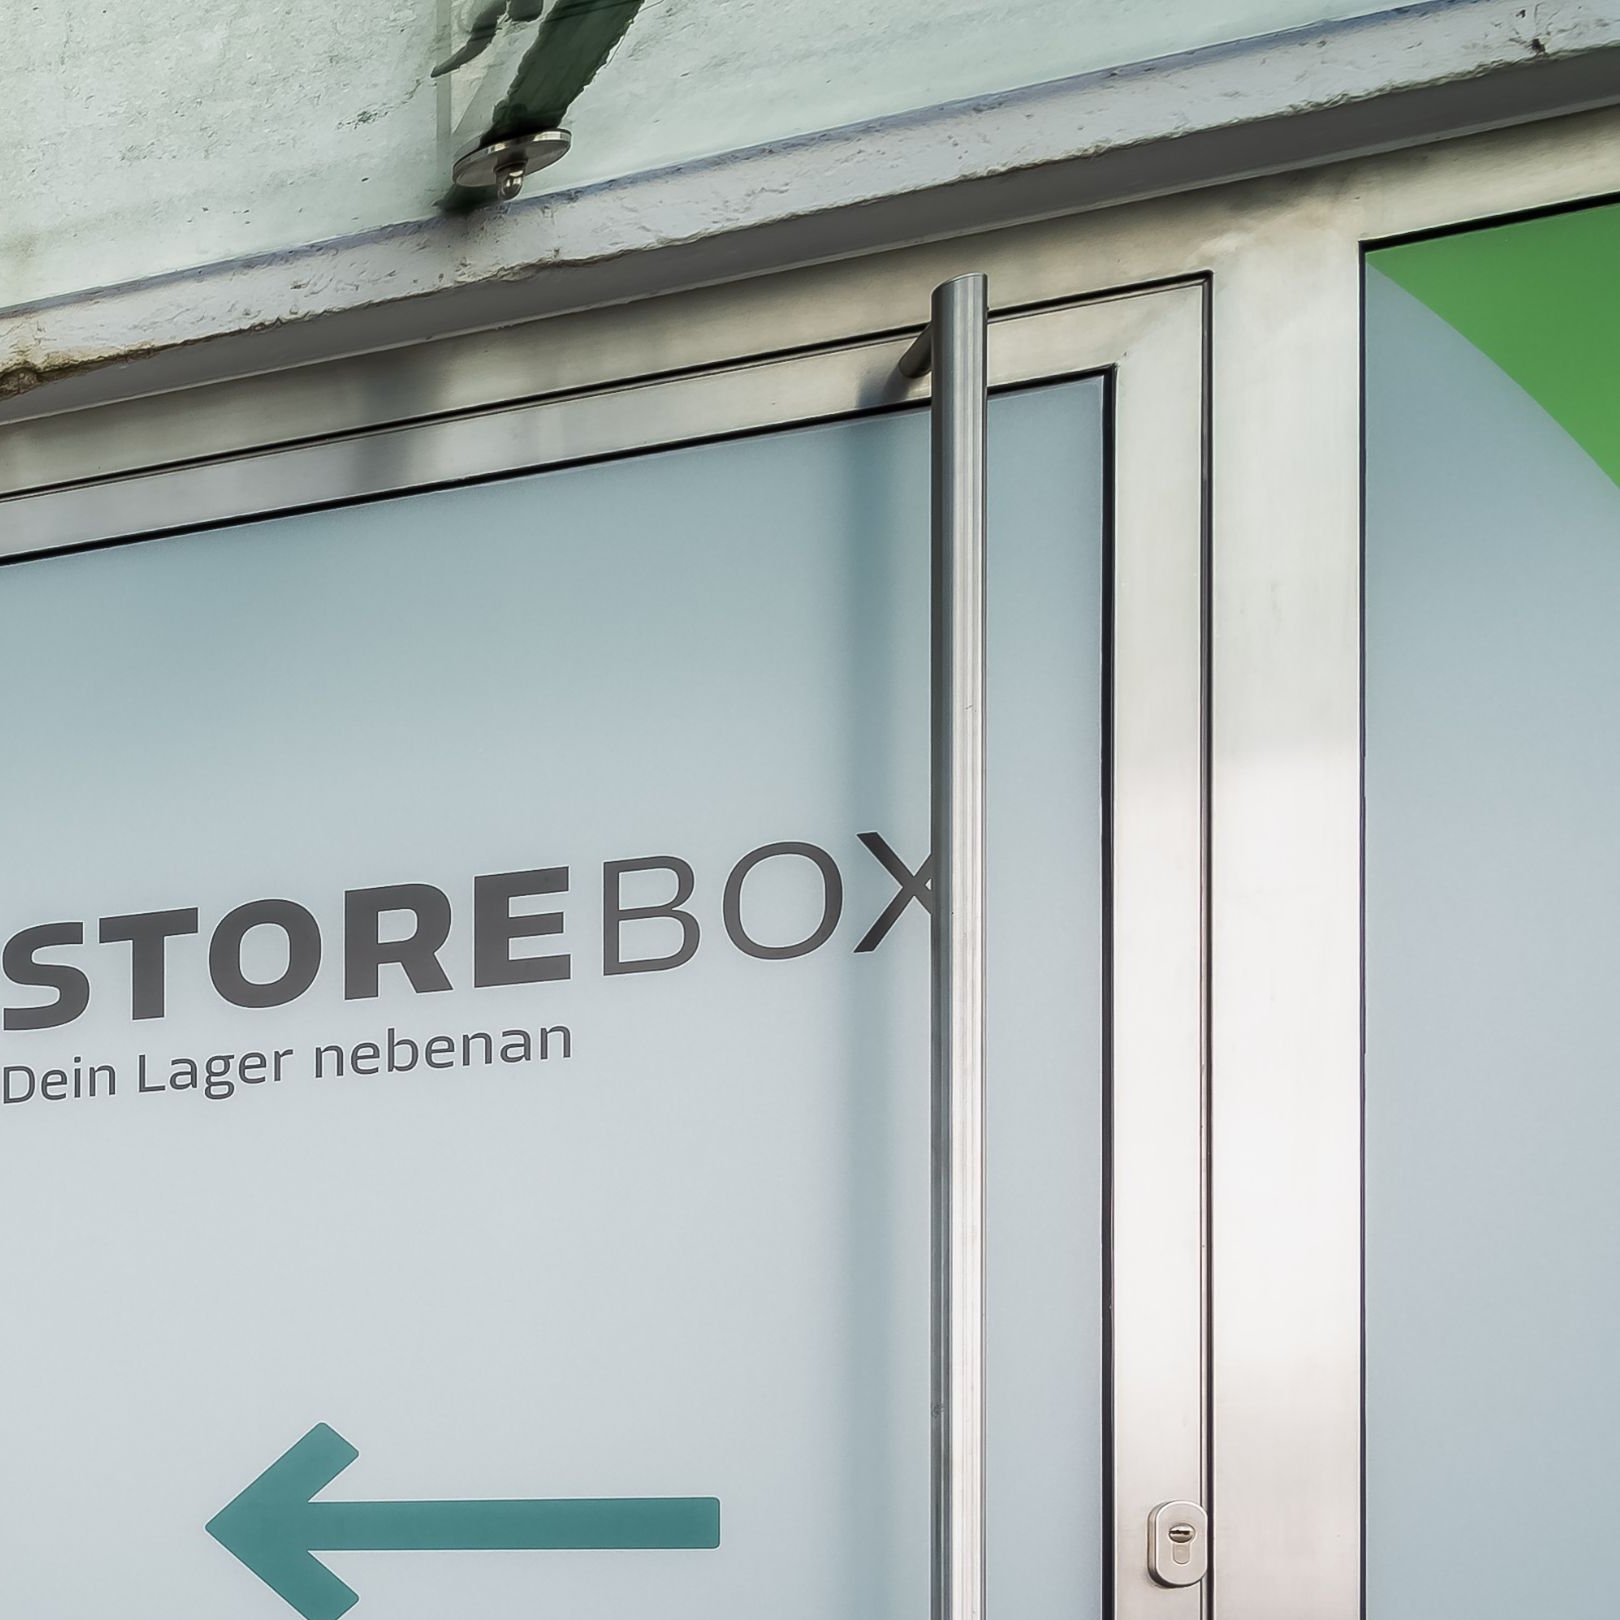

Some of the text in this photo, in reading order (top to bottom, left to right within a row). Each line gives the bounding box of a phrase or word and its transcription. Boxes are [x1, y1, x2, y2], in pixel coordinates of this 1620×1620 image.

[1, 830, 933, 1031] STOREBOX
[2, 1024, 572, 1104] Dein Lager nebenan
